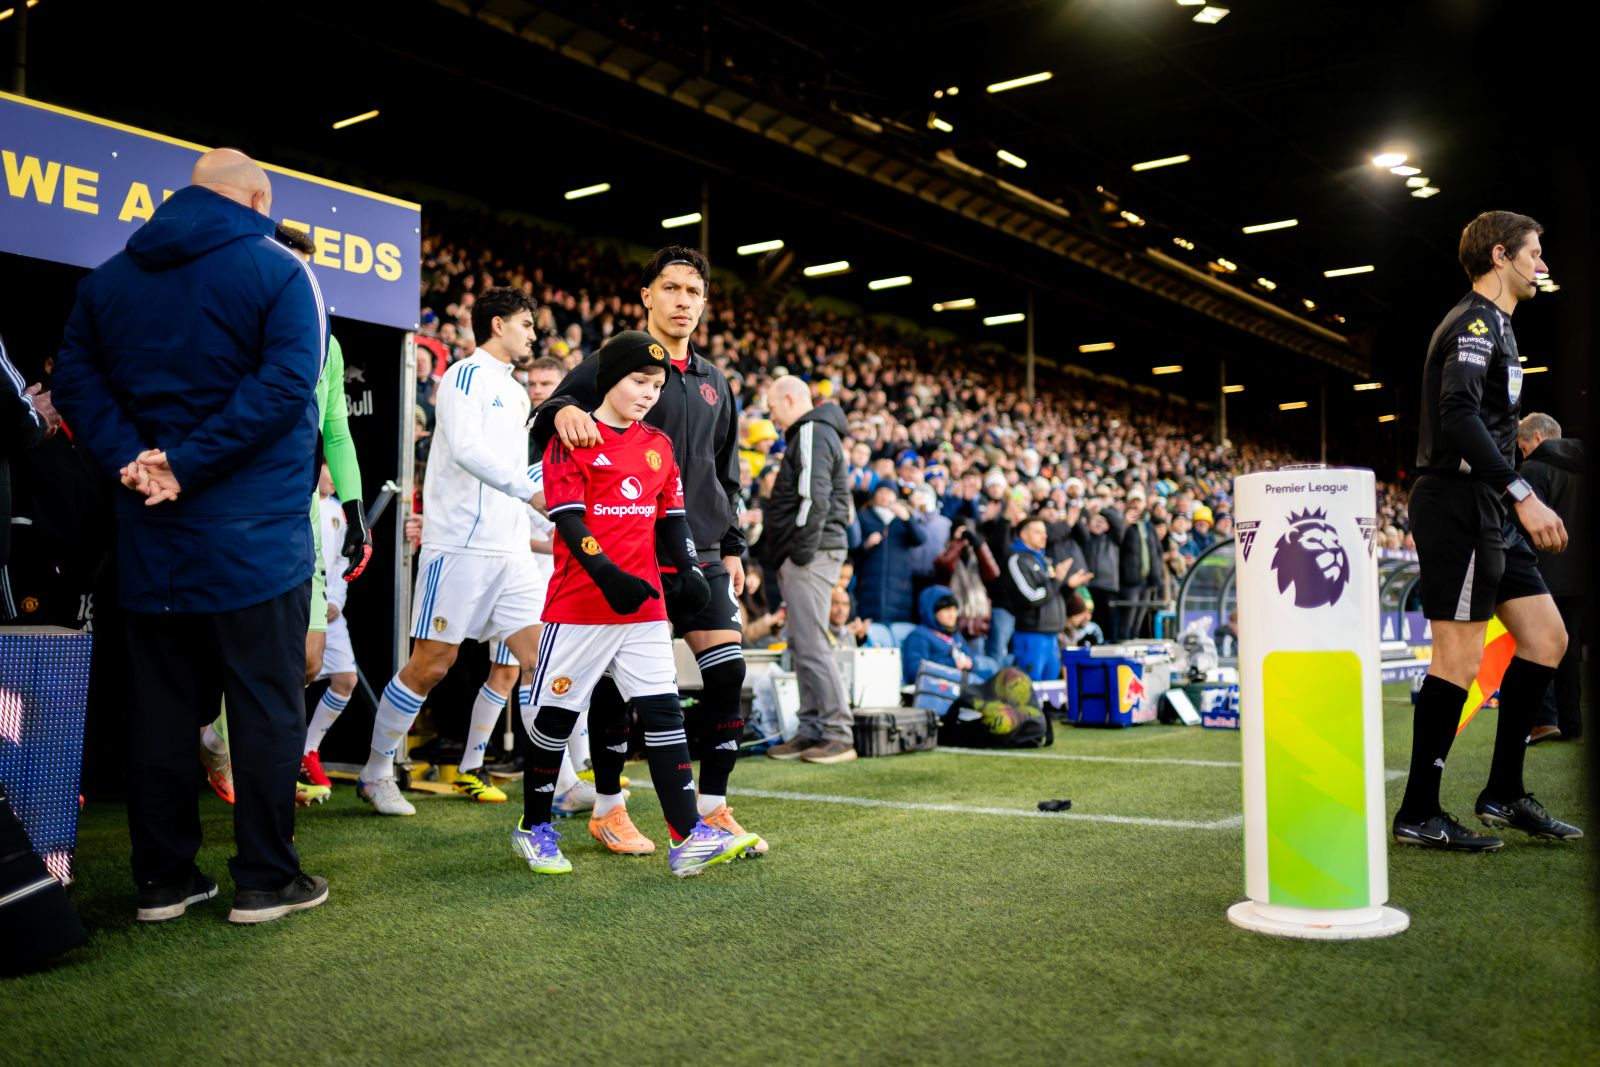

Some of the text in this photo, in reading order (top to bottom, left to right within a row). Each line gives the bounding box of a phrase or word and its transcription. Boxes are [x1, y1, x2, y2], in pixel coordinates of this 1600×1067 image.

[2, 150, 99, 215] WE
[281, 217, 403, 282] EDS
[1265, 482, 1349, 495] Premier League
